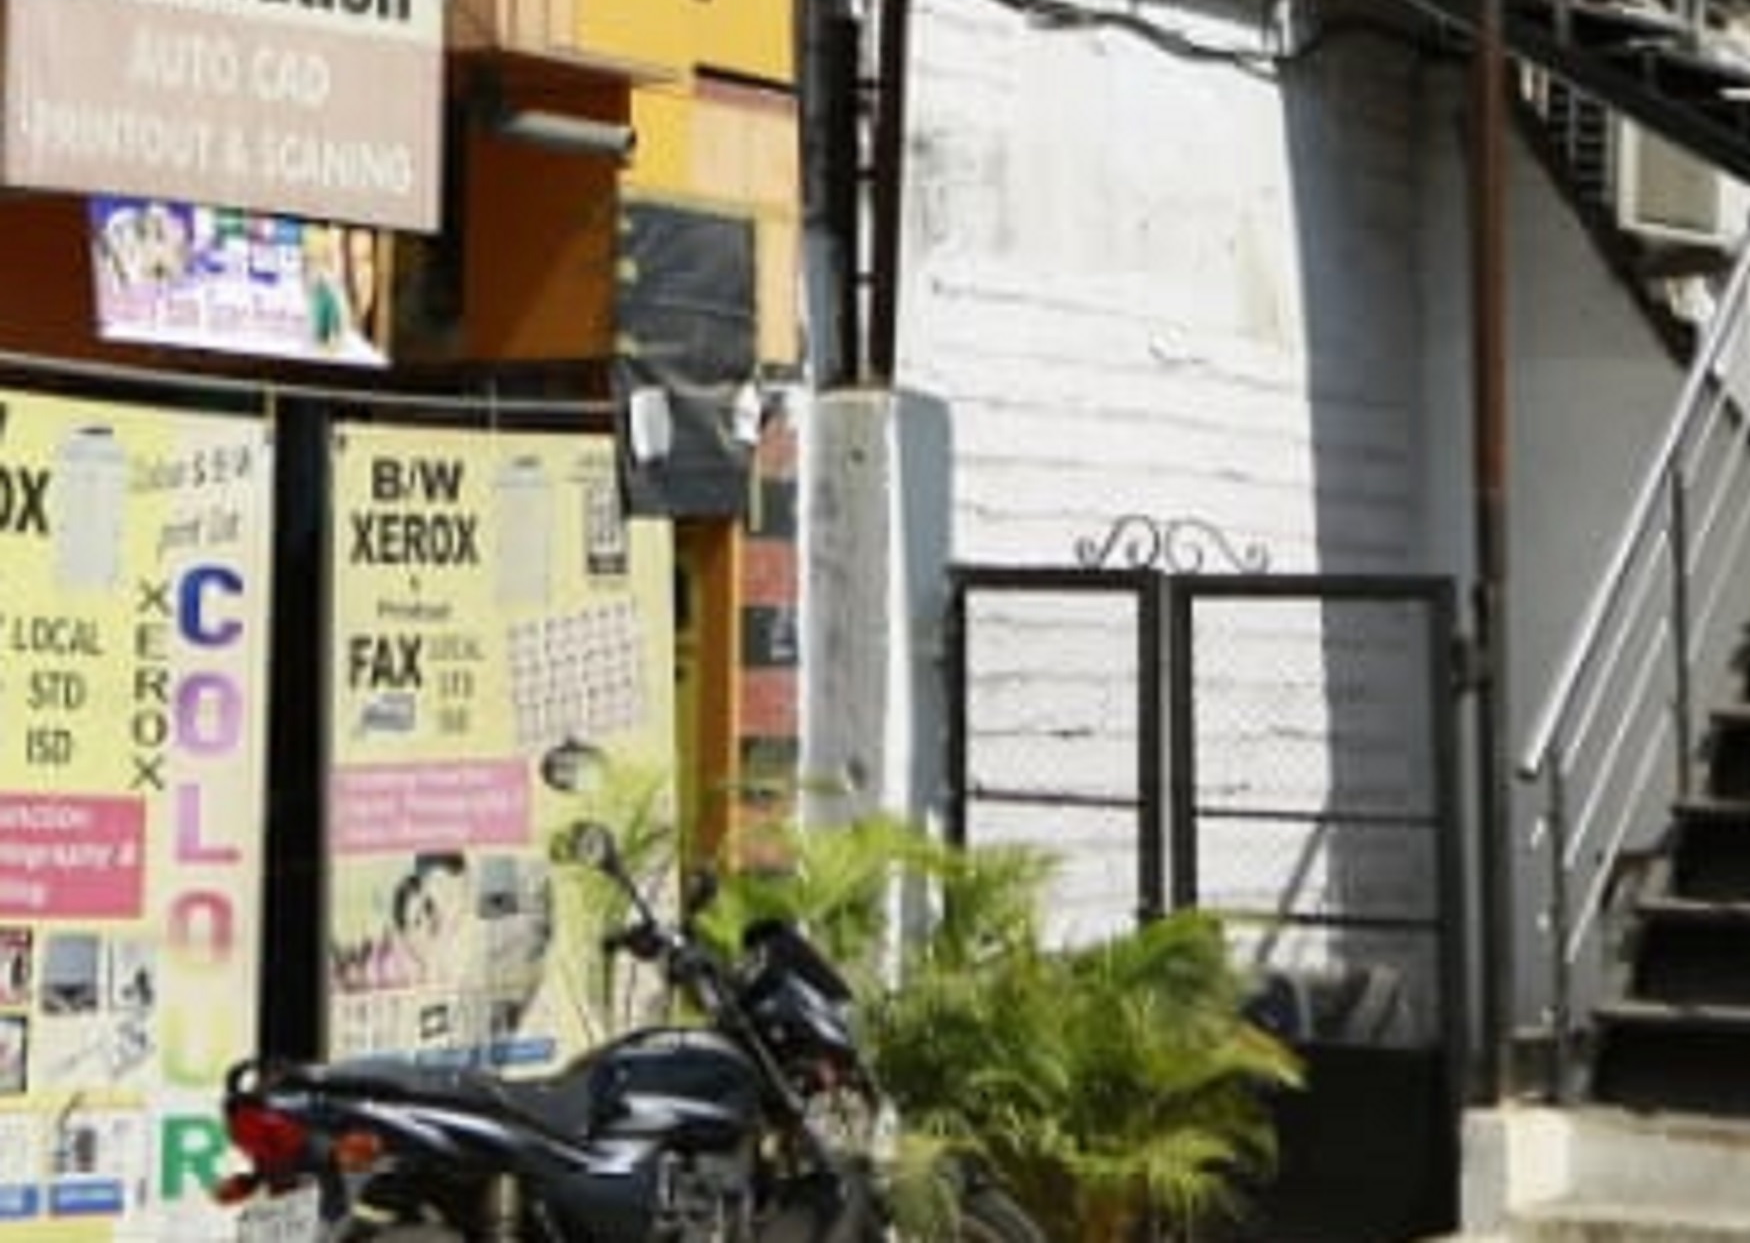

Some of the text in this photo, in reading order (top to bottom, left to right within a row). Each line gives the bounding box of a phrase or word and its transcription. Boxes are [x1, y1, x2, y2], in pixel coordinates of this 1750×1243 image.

[126, 24, 332, 109] AUTO CAD
[371, 459, 464, 504] B/W
[350, 514, 480, 564] XEROX
[10, 616, 104, 656] LOCAL
[349, 634, 422, 689] FAX
[27, 670, 86, 711] STD
[130, 580, 170, 791] XEROX
[26, 729, 73, 765] ISD
